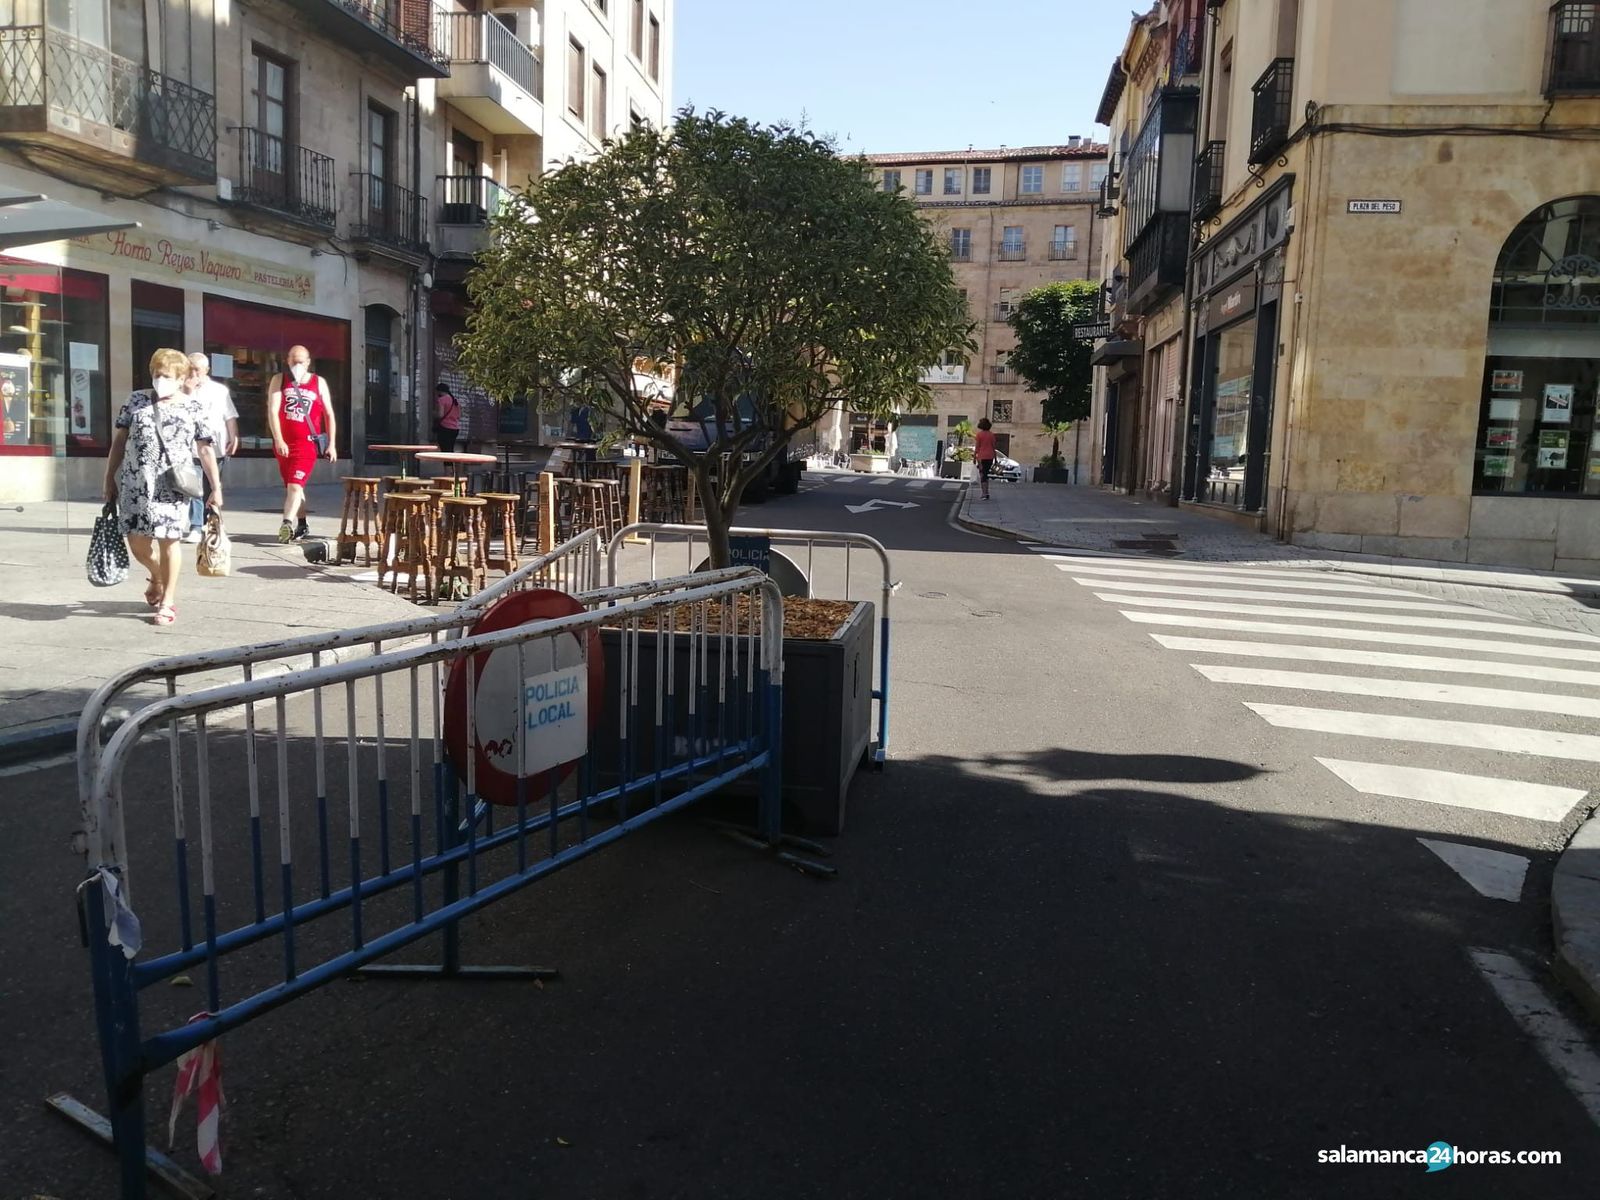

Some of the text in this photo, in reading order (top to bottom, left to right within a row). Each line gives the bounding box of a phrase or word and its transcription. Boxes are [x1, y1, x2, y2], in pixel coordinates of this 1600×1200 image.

[157, 239, 195, 274] Reyes
[198, 249, 241, 281] Vaquero
[284, 396, 313, 416] 23
[525, 675, 580, 706] POLICIA
[527, 701, 576, 730] LOCAL
